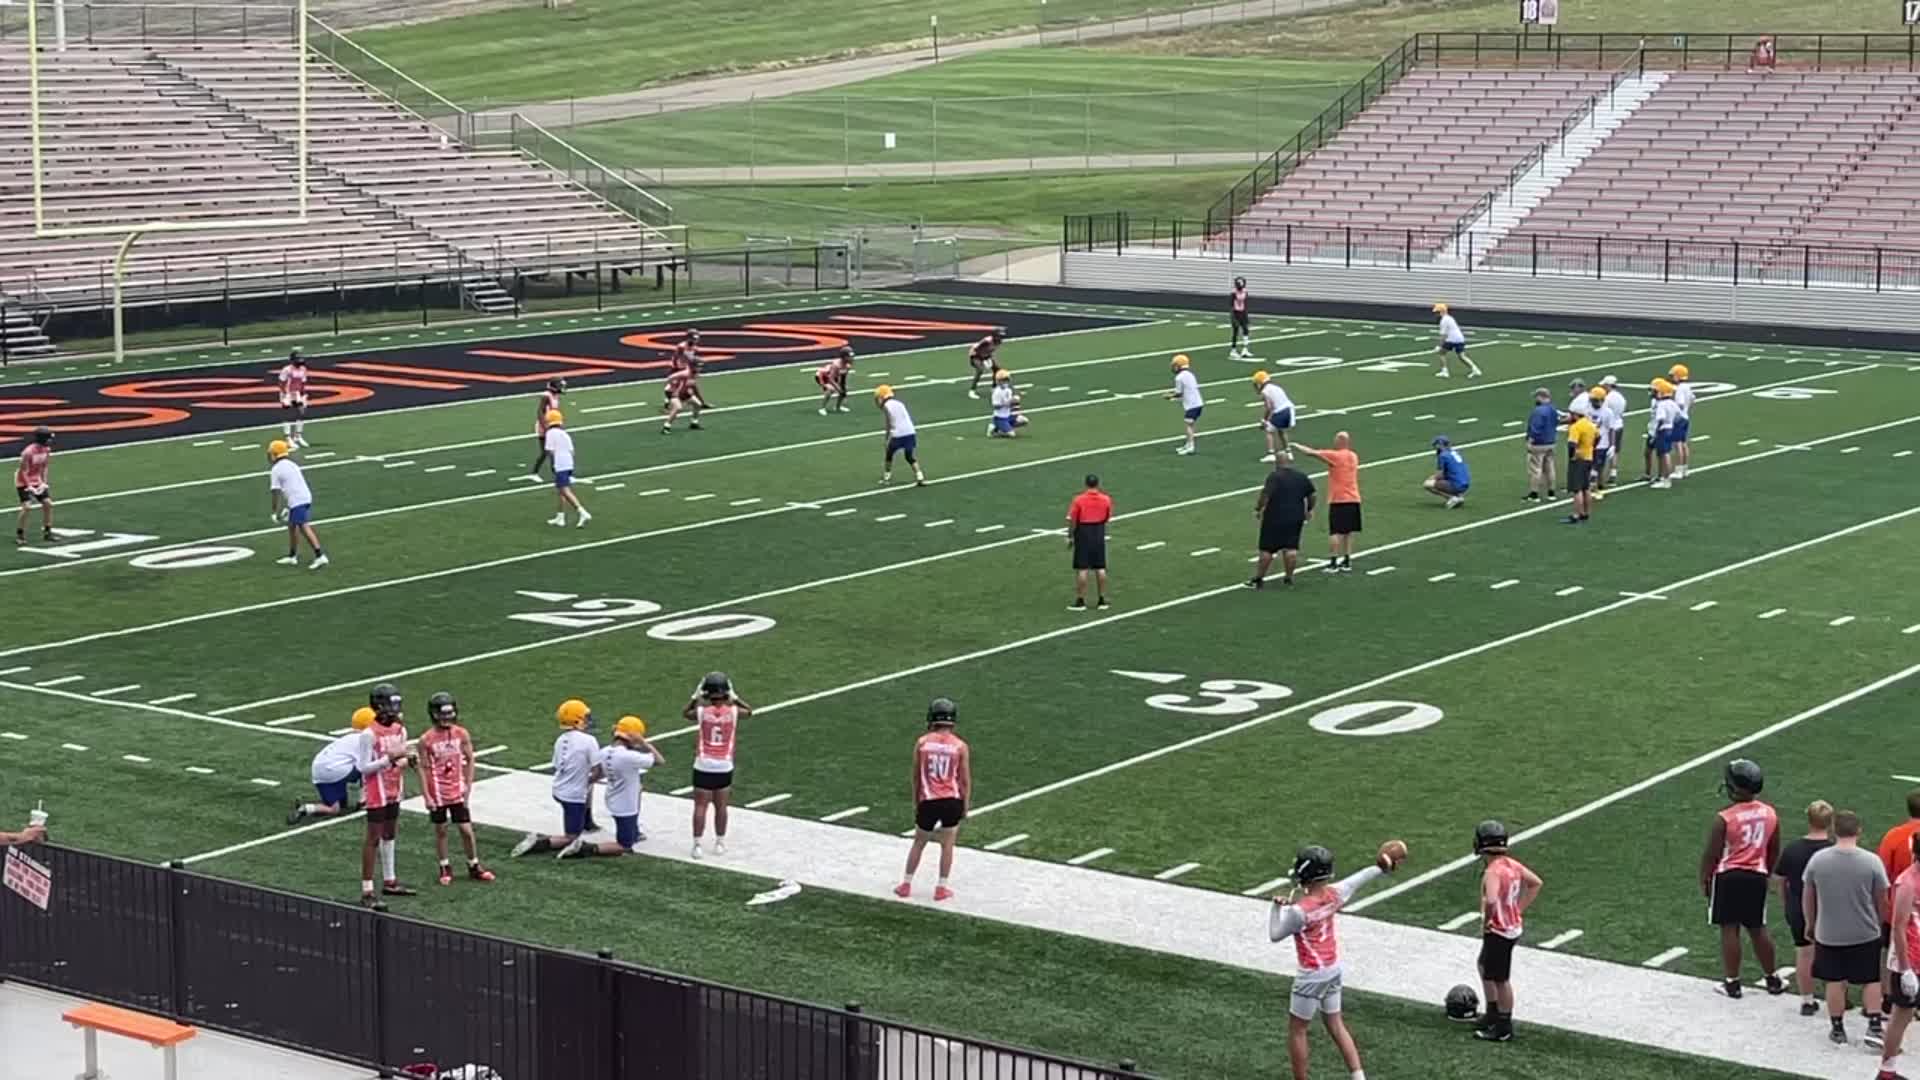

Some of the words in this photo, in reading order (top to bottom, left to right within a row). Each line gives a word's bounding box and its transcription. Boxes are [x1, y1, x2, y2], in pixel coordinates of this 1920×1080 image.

[1905, 0, 1920, 21] 17
[0, 315, 1006, 442] SSILLON
[506, 598, 777, 641] 20
[1144, 679, 1444, 736] 30
[711, 725, 723, 746] 6
